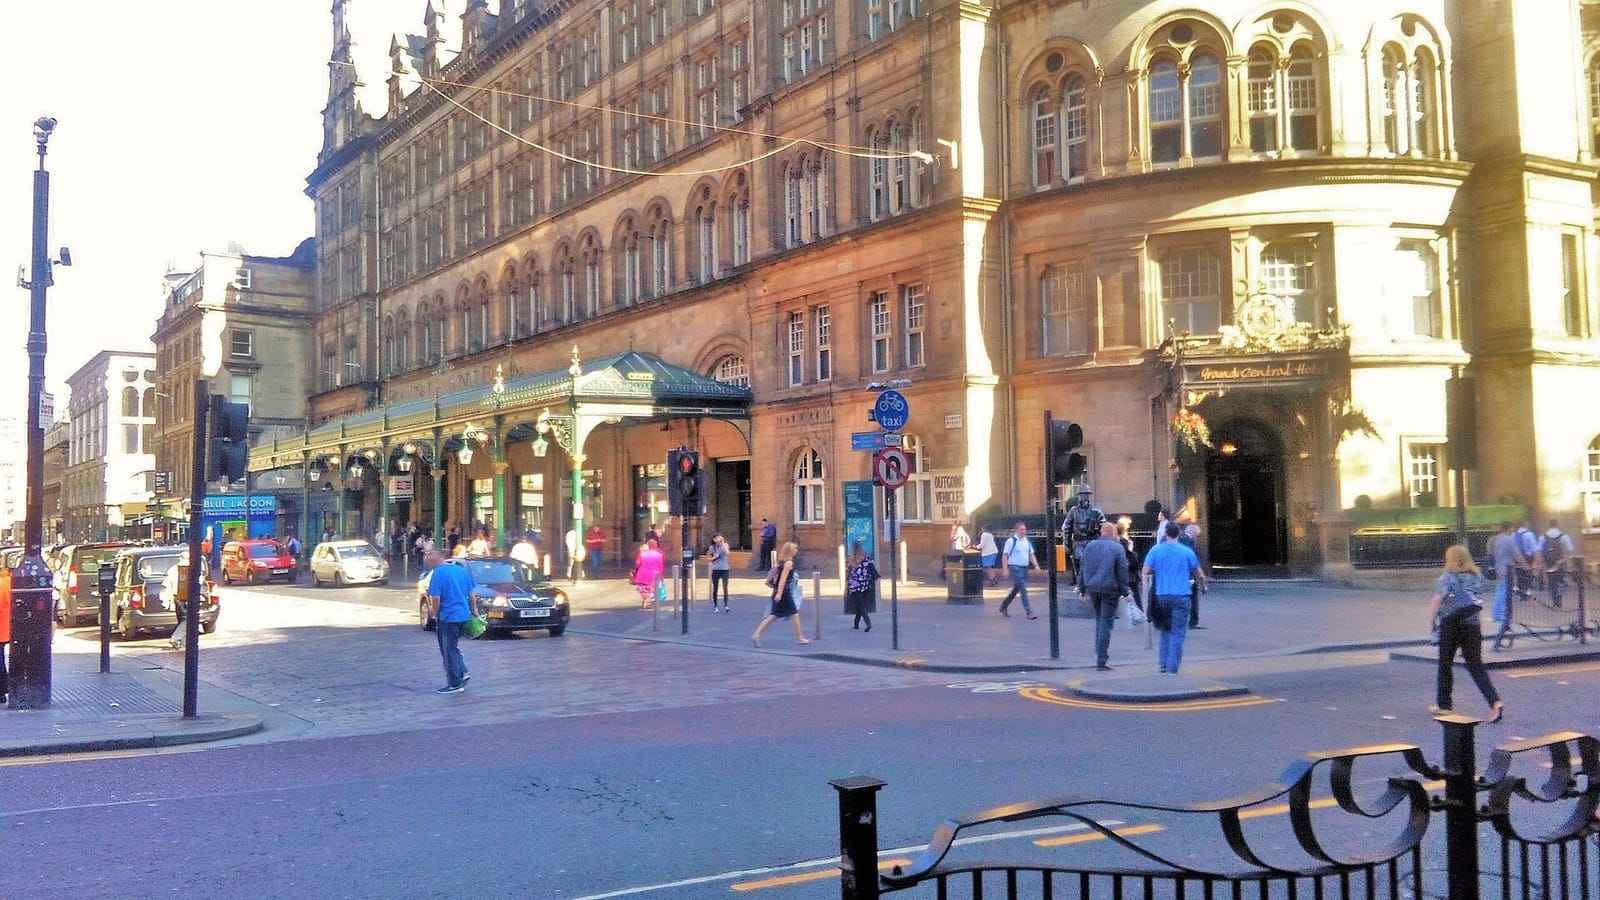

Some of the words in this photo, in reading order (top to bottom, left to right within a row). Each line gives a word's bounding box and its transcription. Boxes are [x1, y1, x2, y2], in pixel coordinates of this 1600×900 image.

[1200, 367, 1239, 380] Grand
[1240, 363, 1292, 378] Central
[883, 415, 902, 427] taxi
[203, 499, 226, 508] BLUE
[934, 491, 965, 504] VEHICLES
[941, 505, 959, 519] ONLY
